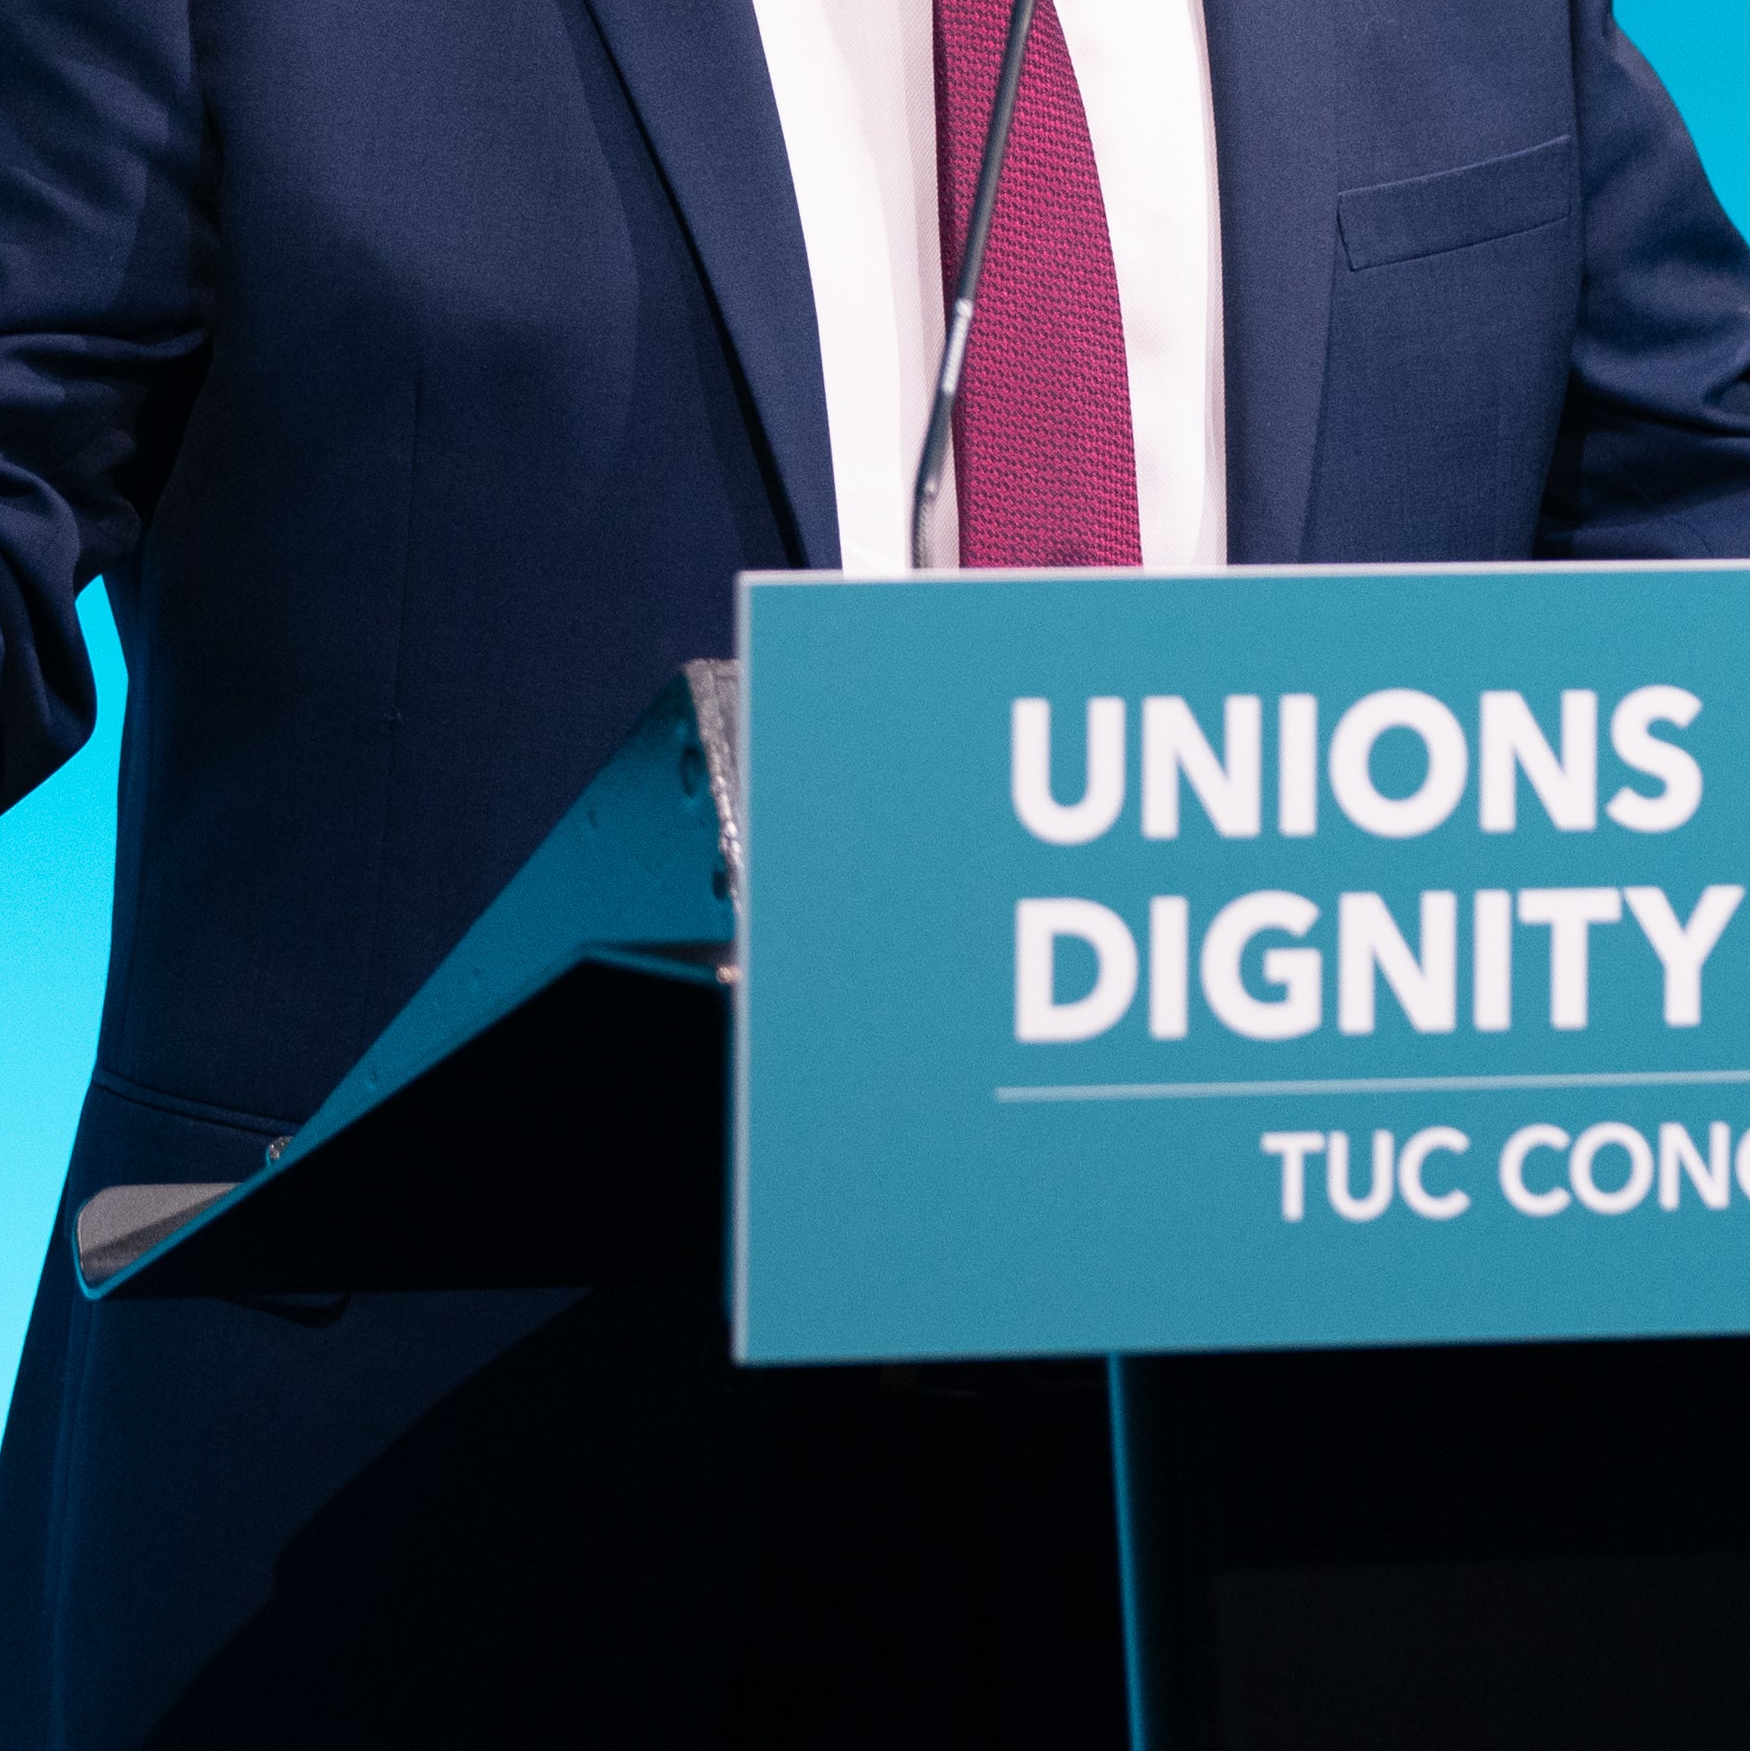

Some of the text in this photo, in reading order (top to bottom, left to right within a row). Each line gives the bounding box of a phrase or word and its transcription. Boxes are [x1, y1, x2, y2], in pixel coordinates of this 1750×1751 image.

[1010, 684, 1704, 846] UNIONS
[1014, 884, 1746, 1044] DIGNITY
[1260, 1125, 1471, 1222] TUC
